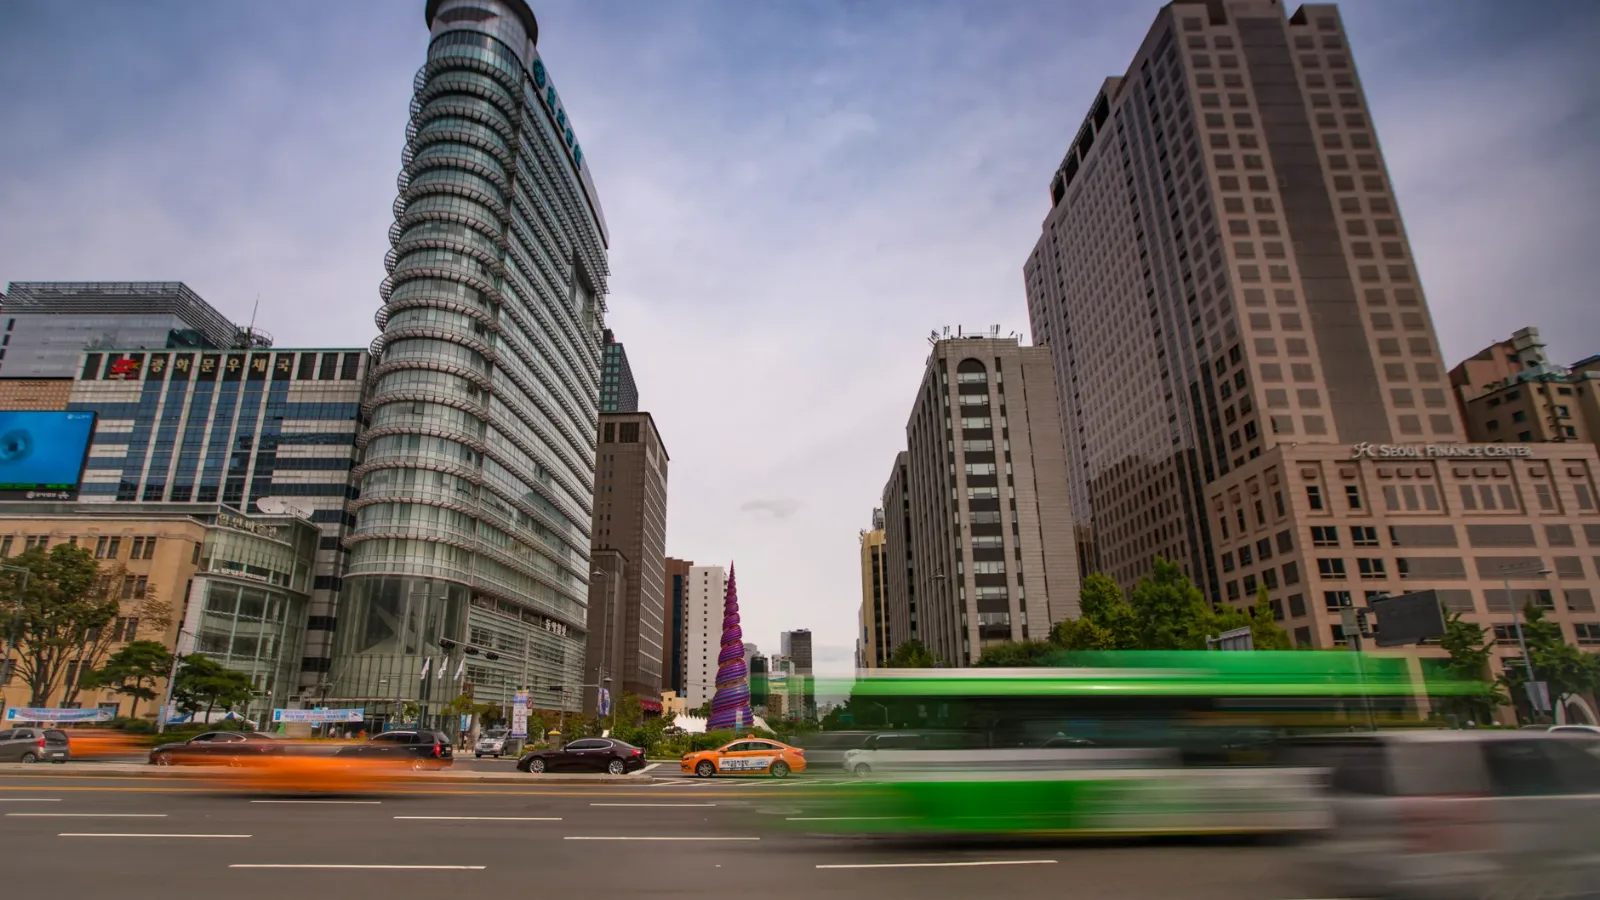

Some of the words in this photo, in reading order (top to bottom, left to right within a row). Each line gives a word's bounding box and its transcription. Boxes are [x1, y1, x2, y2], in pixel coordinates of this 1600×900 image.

[151, 358, 291, 373] 광화문우체국
[1379, 444, 1424, 458] SEOUL
[1426, 444, 1483, 457] FINANCE
[1484, 444, 1533, 457] CENTER
